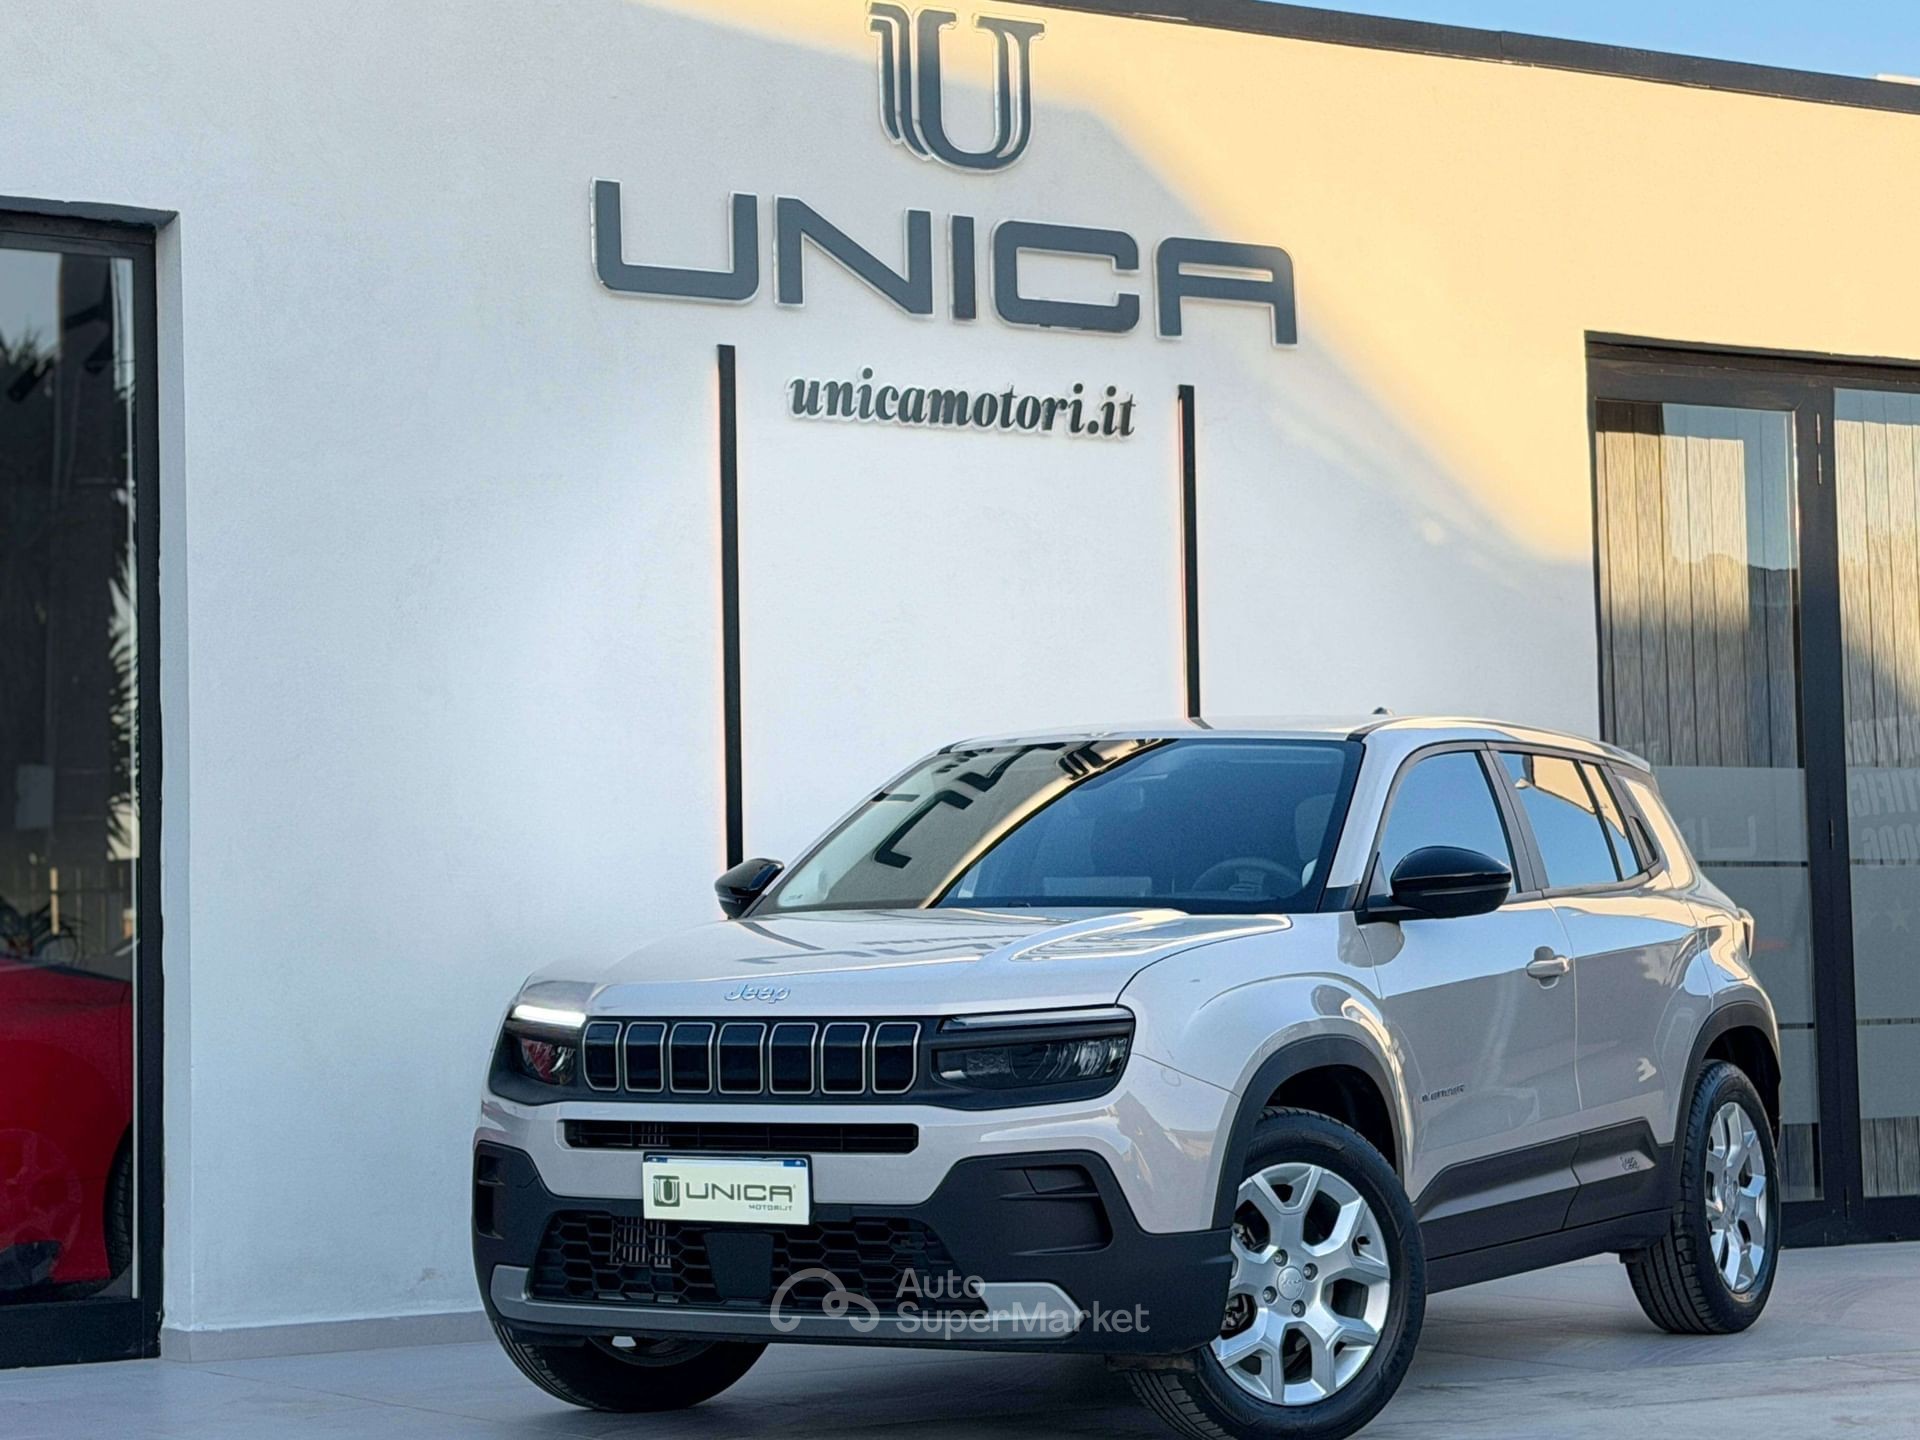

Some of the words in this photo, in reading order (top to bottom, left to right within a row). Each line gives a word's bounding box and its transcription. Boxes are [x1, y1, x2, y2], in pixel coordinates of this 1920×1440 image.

[594, 180, 1298, 345] UNICA
[790, 367, 1137, 437] unicamotori.it
[724, 983, 791, 1004] Jeep
[685, 1182, 793, 1203] UNICA
